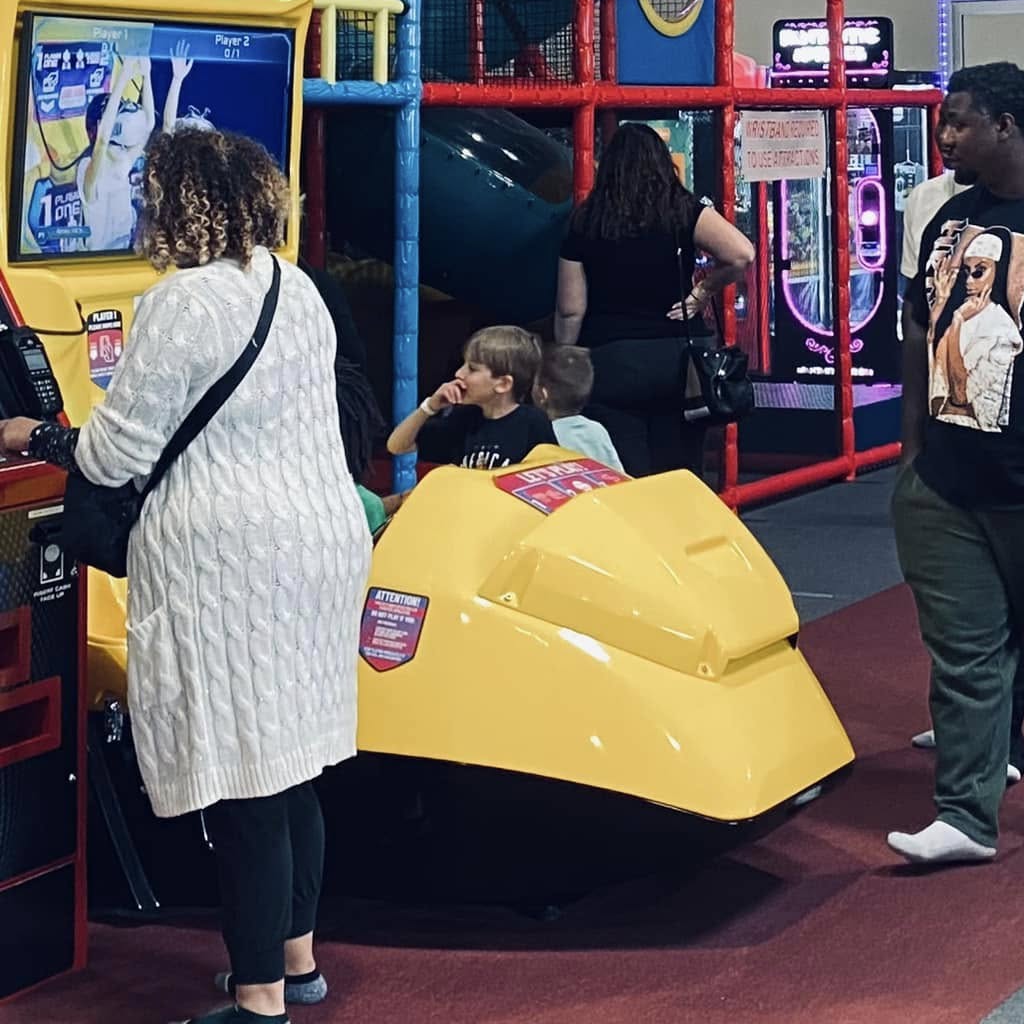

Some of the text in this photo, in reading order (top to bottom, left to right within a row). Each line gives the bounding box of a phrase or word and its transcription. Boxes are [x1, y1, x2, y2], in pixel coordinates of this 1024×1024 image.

[92, 27, 122, 41] Player
[215, 34, 250, 47] Player 2
[224, 48, 240, 59] 0/1
[745, 119, 790, 138] WRISTBAND
[747, 148, 820, 168] TO USE ATTRACTIONS
[92, 311, 113, 323] PLAYER
[374, 590, 421, 608] ATTENTION!
